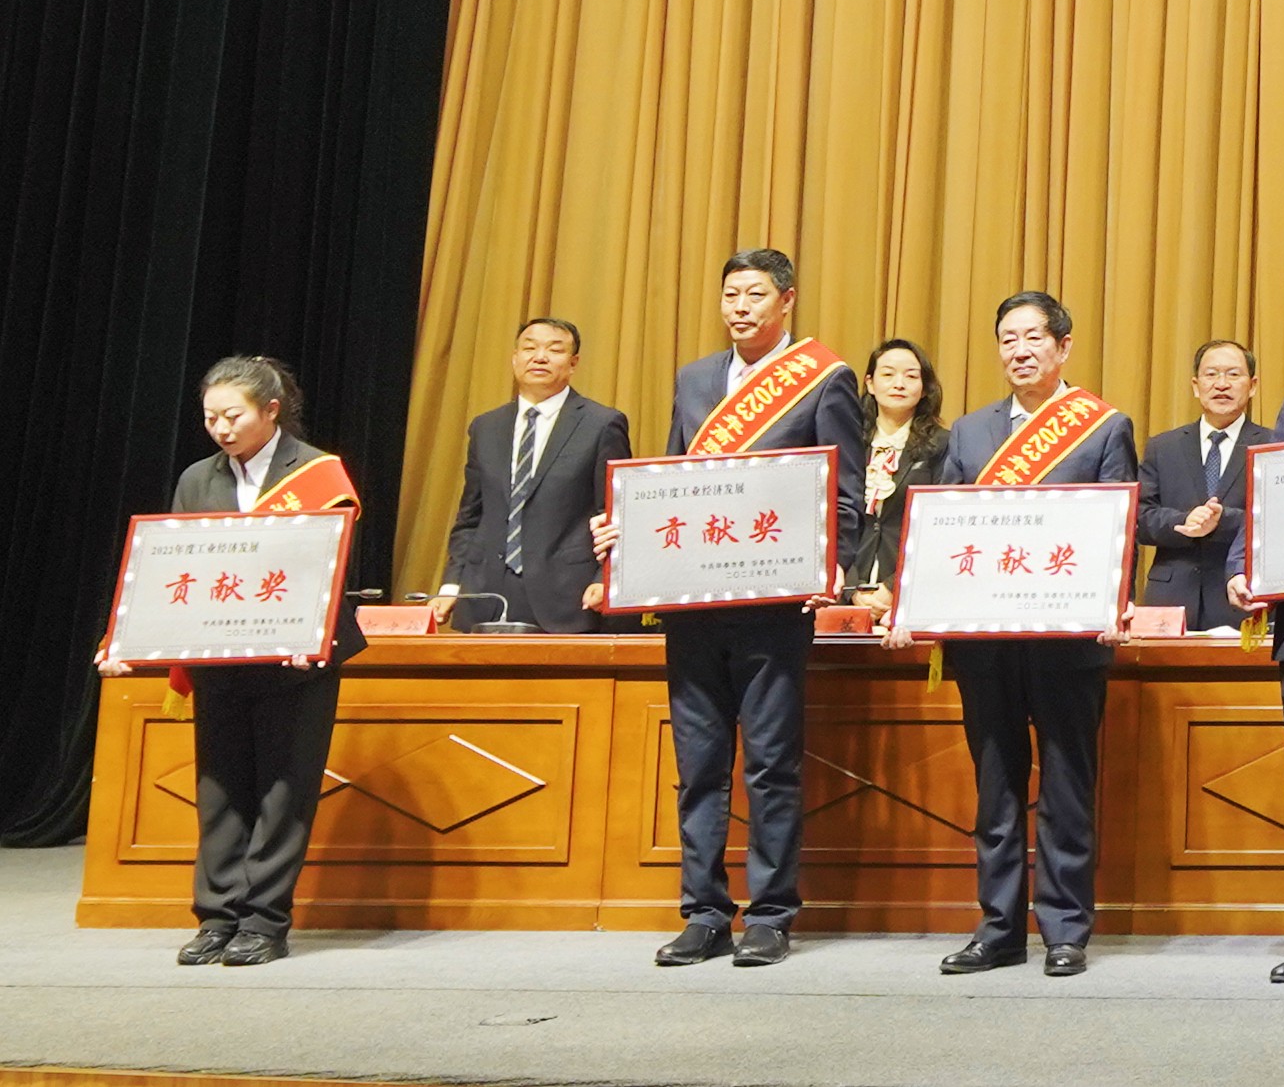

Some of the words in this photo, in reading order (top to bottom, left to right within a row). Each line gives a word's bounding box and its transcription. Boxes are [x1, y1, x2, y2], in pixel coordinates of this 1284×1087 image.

[634, 483, 744, 500] 2022年度工业经济发展
[655, 509, 782, 549] 贡献奖
[950, 543, 1078, 577] 贡献奖
[165, 569, 288, 605] 贡献奖
